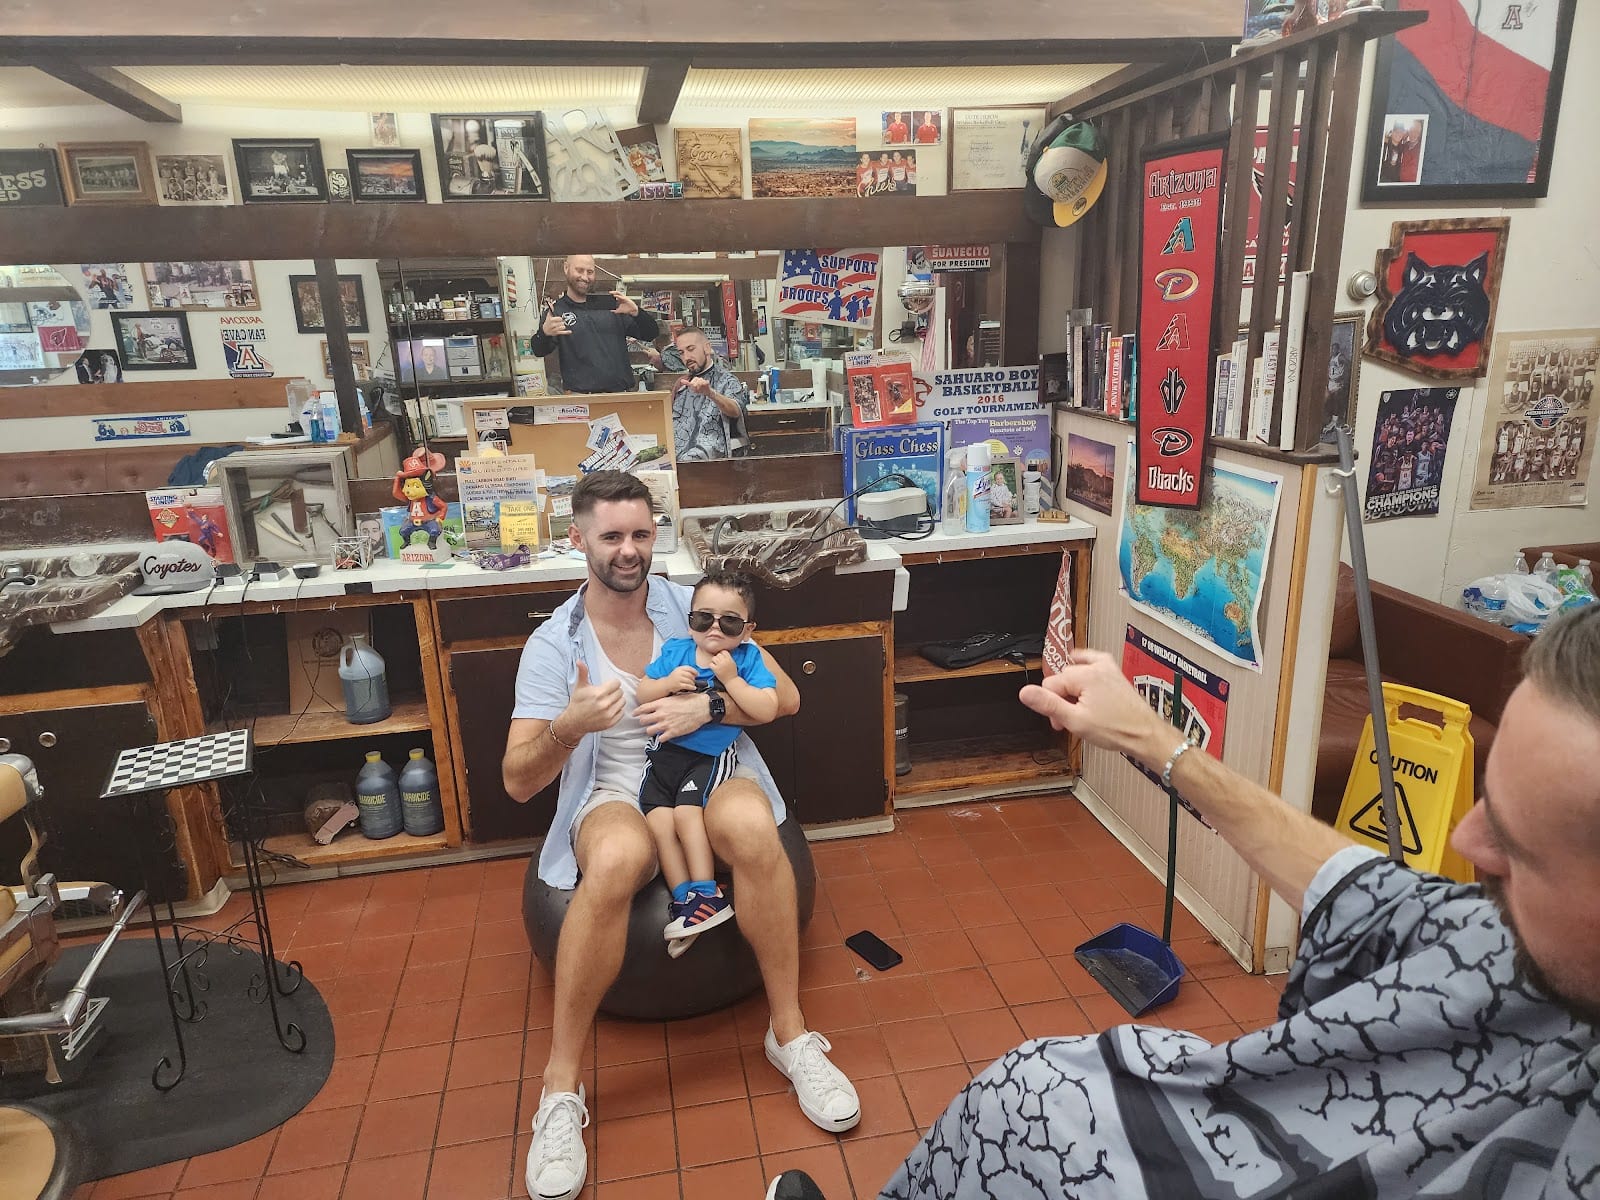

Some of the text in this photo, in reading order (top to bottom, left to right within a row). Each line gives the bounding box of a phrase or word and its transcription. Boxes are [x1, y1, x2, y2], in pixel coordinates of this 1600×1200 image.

[1501, 4, 1524, 30] A
[1149, 168, 1217, 198] Arizona
[932, 246, 990, 258] SUAVECITO
[821, 254, 877, 275] SUPPORT
[949, 259, 989, 267] PRESIDENT
[811, 271, 838, 288] OUR
[782, 286, 829, 305] TROOPS
[1287, 346, 1298, 384] ARIZONA
[935, 371, 1005, 385] SAHUARO
[942, 381, 1040, 397] BASKETBALL
[933, 402, 1046, 416] GOLF TOURNAMENT
[989, 418, 1037, 427] Barbershop
[856, 438, 939, 459] Glass Chess
[1366, 488, 1438, 510] CHAMPIONS
[410, 501, 425, 517] A
[144, 556, 202, 579] Coyotes
[401, 553, 434, 563] ARIZONA
[1177, 656, 1208, 685] BASKETBALL
[1370, 750, 1438, 784] CUTION
